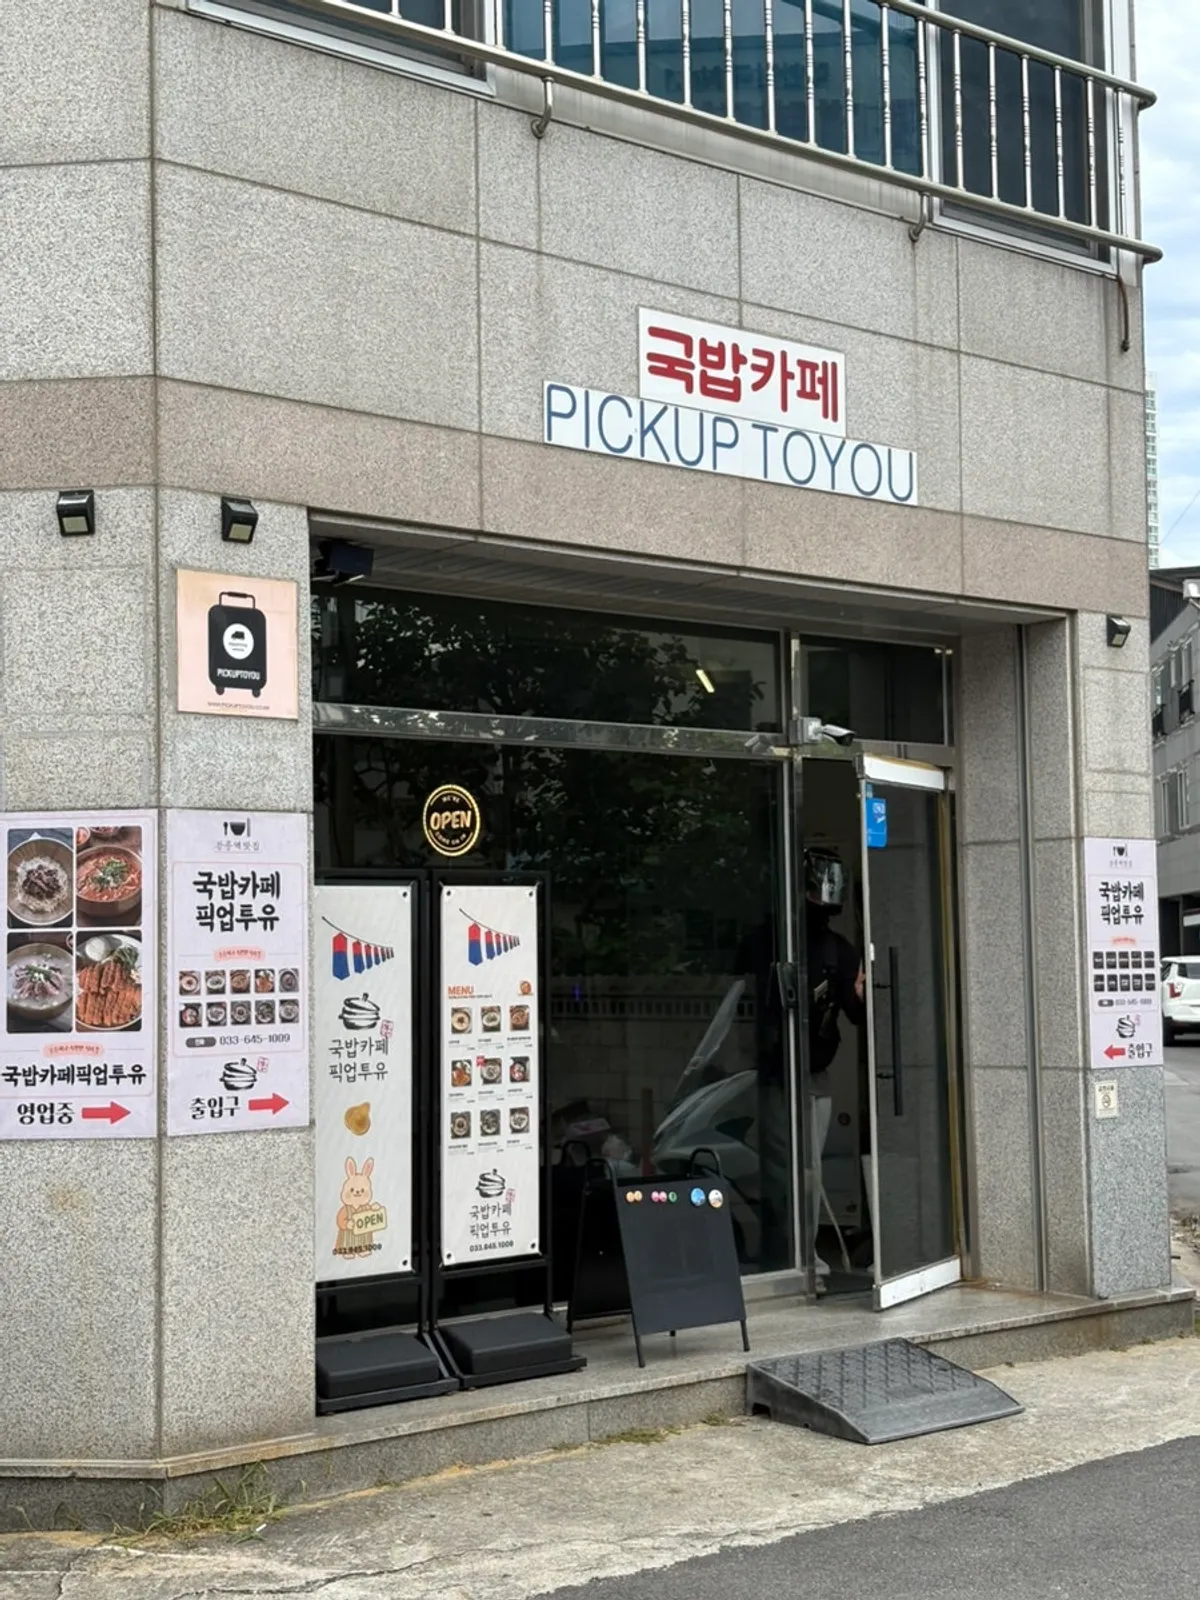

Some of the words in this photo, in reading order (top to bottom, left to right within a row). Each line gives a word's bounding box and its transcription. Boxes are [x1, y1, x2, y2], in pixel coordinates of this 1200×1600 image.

[646, 326, 839, 423] 국밥카페
[546, 383, 740, 472] PICKUP
[751, 422, 914, 502] TOYOU
[217, 668, 260, 680] PICKUPTOYOU
[430, 810, 472, 831] OPEN
[192, 870, 281, 901] 국밥카페
[1098, 880, 1144, 902] 국밥카페
[195, 902, 280, 933] 픽업투유
[1100, 903, 1144, 926] 픽업투유
[447, 986, 474, 996] MENU
[219, 1032, 291, 1046] 033-645-1009
[328, 1035, 390, 1059] 국밥카페
[1127, 1042, 1153, 1060] 출입구
[1, 1063, 147, 1088] 국밥카페픽업투유
[328, 1060, 389, 1083] 픽업투유
[16, 1101, 75, 1126] 영업중
[189, 1095, 242, 1120] 출입구
[356, 1211, 384, 1230] OPEN
[469, 1201, 513, 1221] 국밥카페
[469, 1220, 512, 1240] 픽업투유
